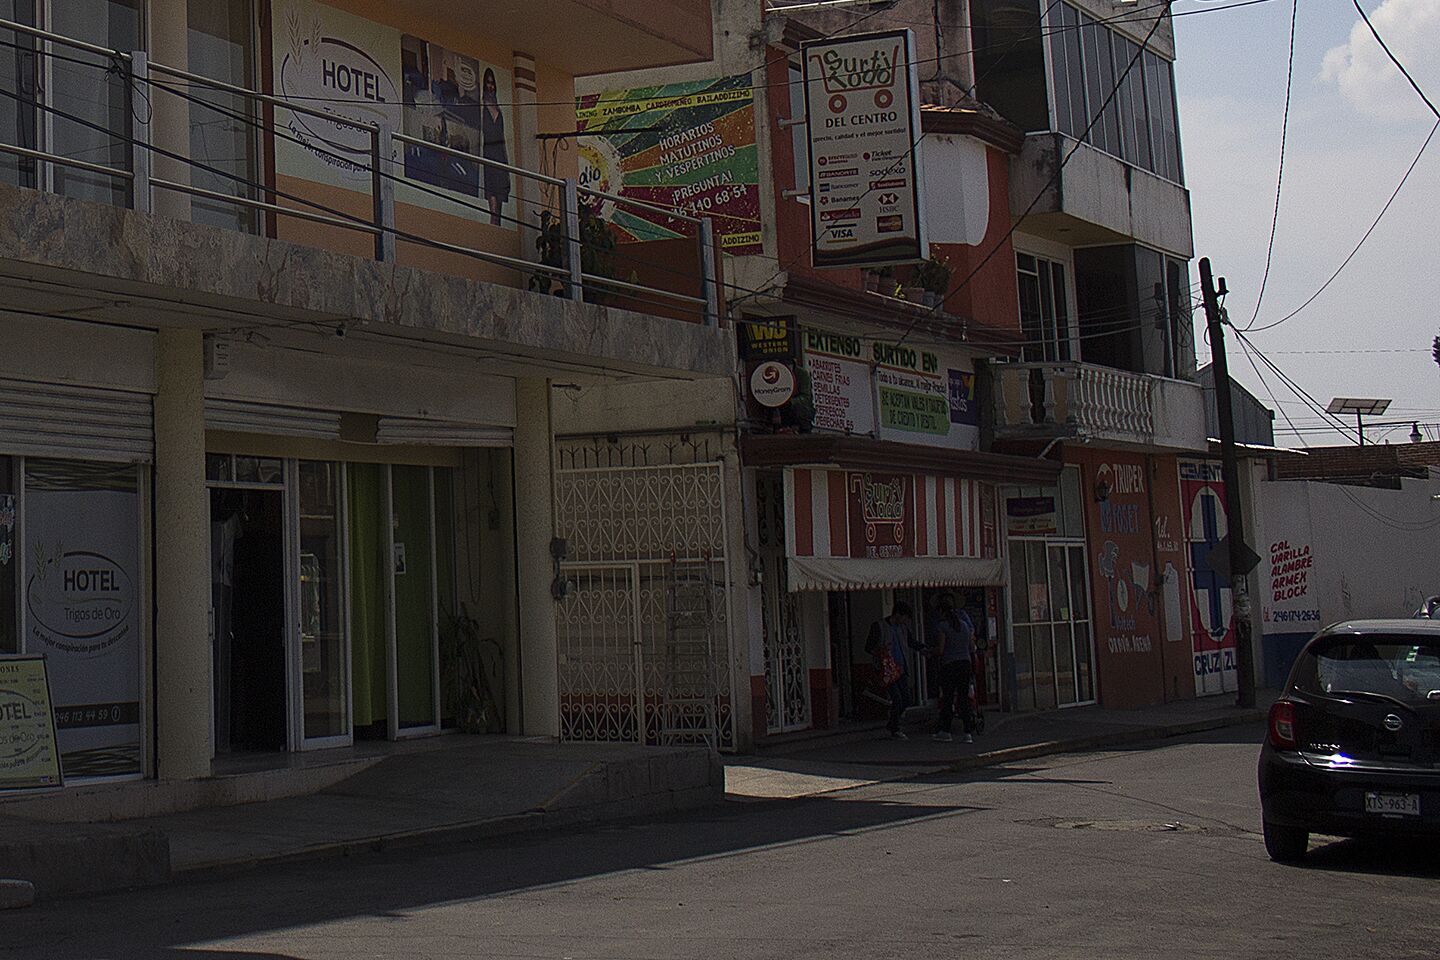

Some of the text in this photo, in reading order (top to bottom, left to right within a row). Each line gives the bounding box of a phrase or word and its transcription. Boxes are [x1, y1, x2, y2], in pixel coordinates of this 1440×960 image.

[823, 50, 892, 72] Surti
[323, 58, 386, 102] HOTEL
[825, 111, 898, 129] DEL CENTRO
[659, 121, 715, 152] HORARIOS
[660, 134, 723, 165] MATUTINOS
[655, 144, 736, 183] Y VESPERTINOS
[671, 169, 734, 206] ¡PREGUNTA!
[715, 190, 731, 206] 68
[732, 183, 748, 199] 54
[831, 228, 853, 239] VISA
[808, 334, 861, 356] EXTENSO
[873, 342, 917, 369] SURTIDO
[754, 386, 791, 396] MoneyGram
[813, 380, 841, 396] SEMILLAS
[1112, 463, 1145, 494] TRUPER
[1180, 462, 1222, 481] CEMENT
[1270, 541, 1290, 554] CAL
[1271, 556, 1313, 577] ALAMBRE
[63, 569, 121, 595] HOTEL
[1272, 571, 1307, 590] ARMEX
[1273, 585, 1308, 602] BLOCK
[64, 605, 122, 623] Trigos de Oro
[89, 642, 101, 654] para
[1195, 653, 1221, 676] CRUZ
[98, 709, 109, 720] 59
[21, 731, 36, 742] Oro
